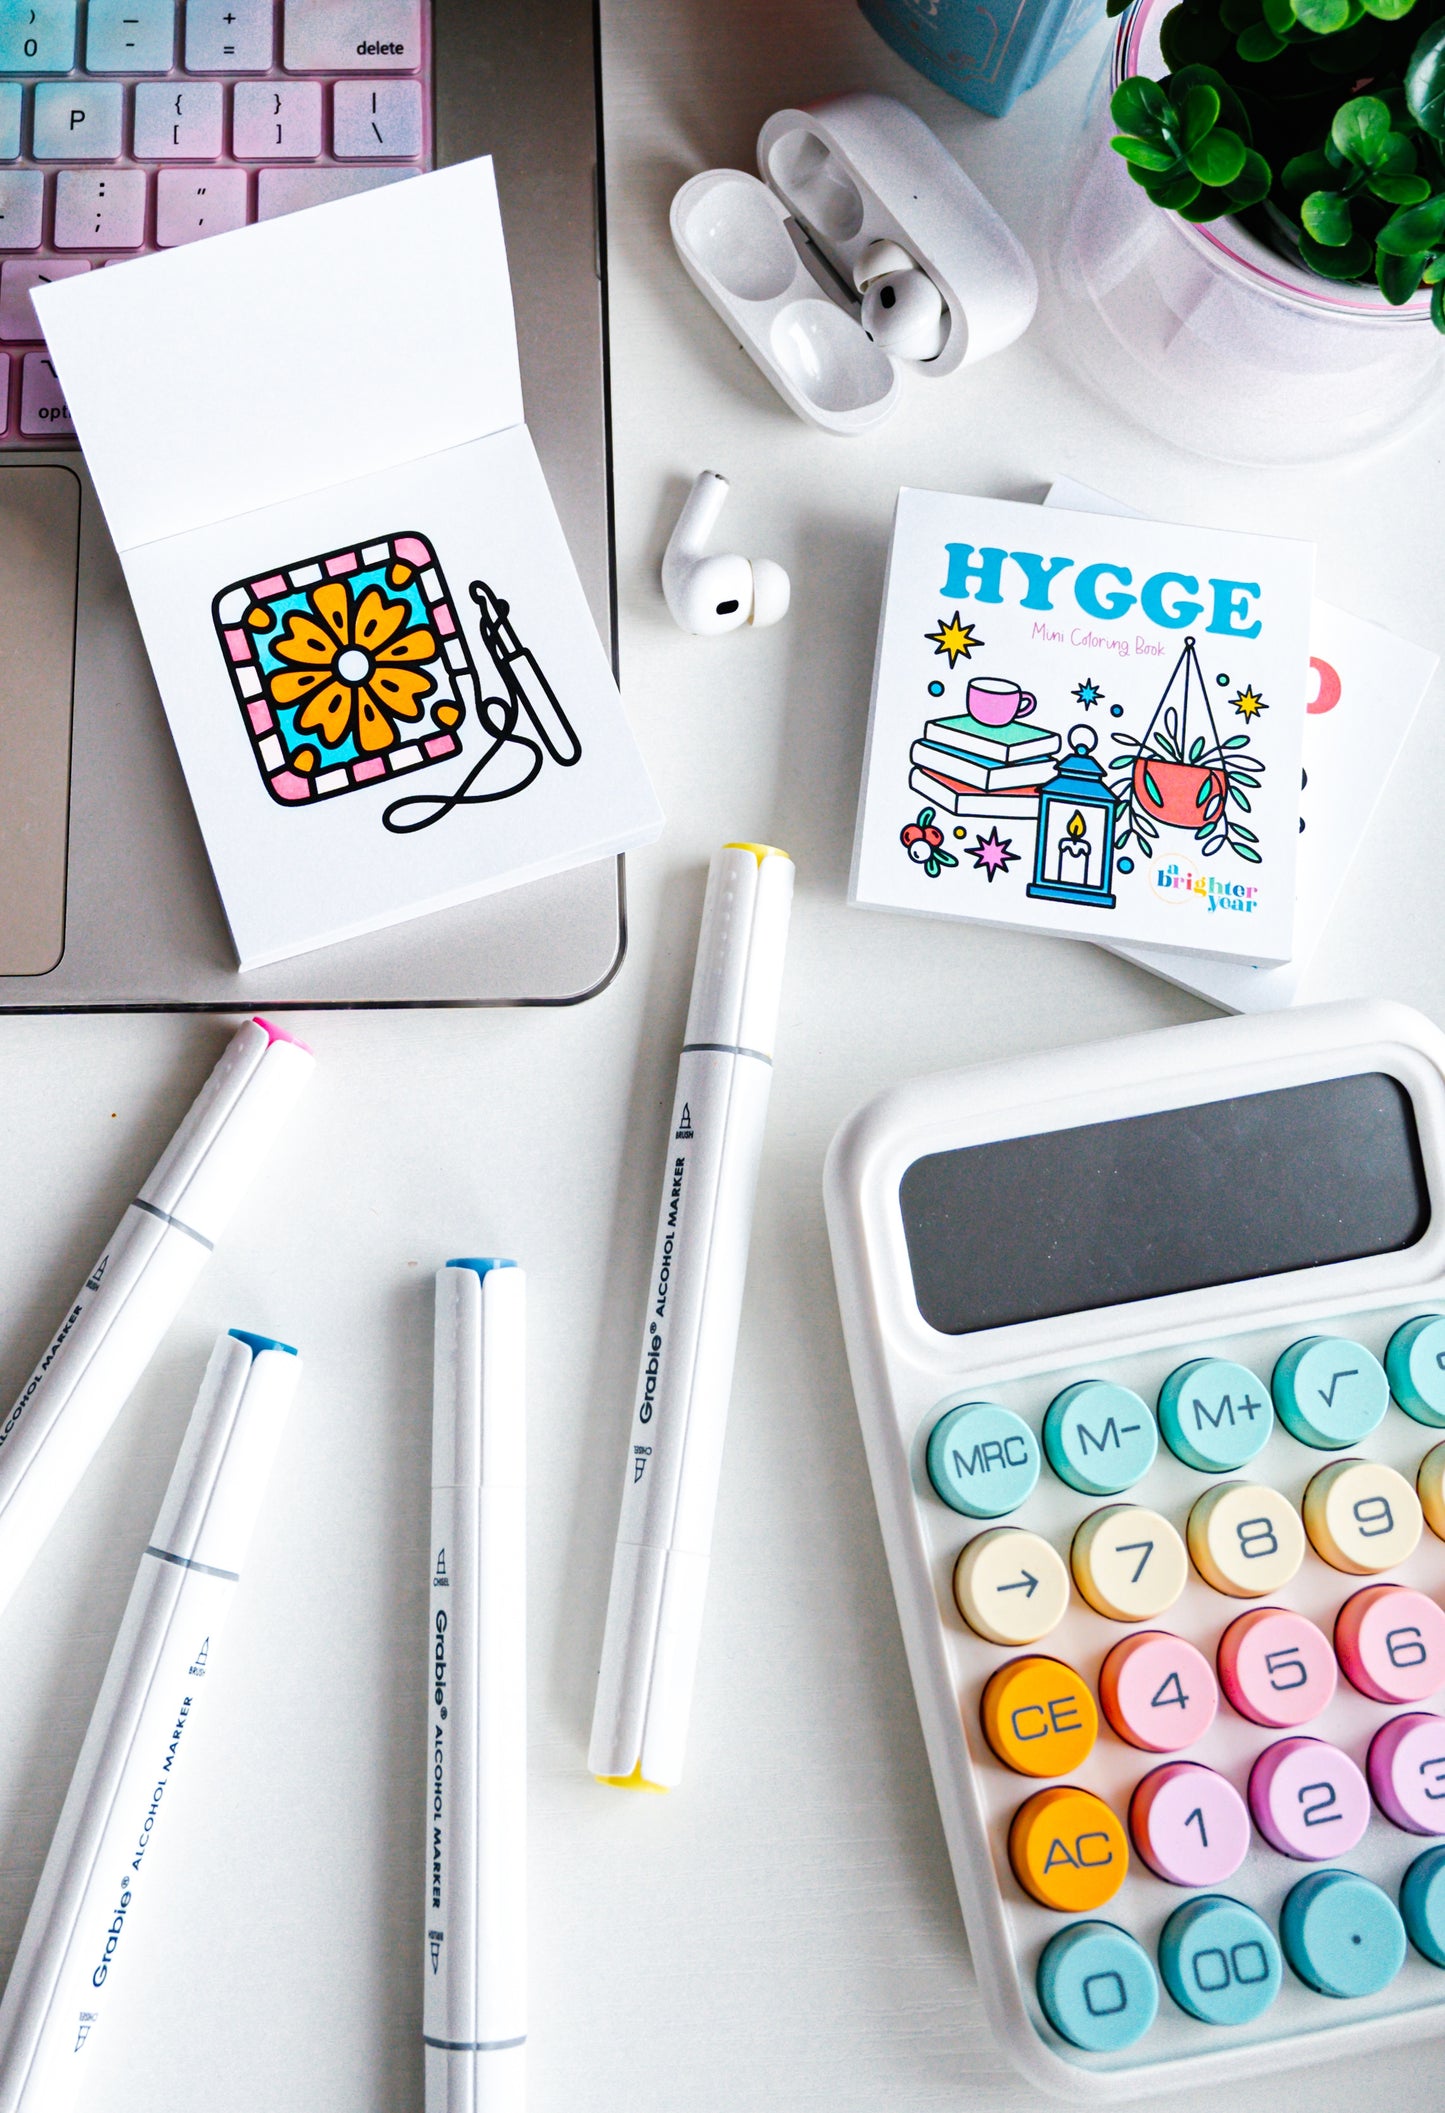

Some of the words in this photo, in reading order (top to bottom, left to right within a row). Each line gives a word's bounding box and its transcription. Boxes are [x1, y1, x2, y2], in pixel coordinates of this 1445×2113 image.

[356, 40, 405, 56] delete
[70, 109, 86, 131] P
[38, 405, 71, 422] opt
[939, 542, 1263, 641] HYGGE
[1032, 622, 1064, 642] Mini
[1070, 627, 1130, 657] Coloring
[1135, 635, 1166, 656] Book
[1157, 869, 1258, 899] brighter
[1167, 864, 1179, 875] a
[1207, 894, 1258, 913] year
[655, 1231, 675, 1317] ALCOHOL
[667, 1157, 685, 1227] MARKER
[0, 1374, 43, 1447] LCOHOL
[41, 1305, 83, 1371] MARKER
[1193, 1394, 1262, 1431] M+
[953, 1436, 1028, 1478] MRC
[1076, 1417, 1141, 1456] M-
[1353, 1496, 1394, 1537] 9
[1237, 1517, 1278, 1559] 8
[1115, 1541, 1154, 1583] 7
[1385, 1626, 1427, 1668] 6
[1265, 1647, 1307, 1691] 5
[1151, 1672, 1189, 1710] 4
[1010, 1695, 1083, 1742] CE
[131, 1778, 168, 1871] ALCOHOL
[162, 1696, 194, 1772] MARKER
[432, 1724, 443, 1822] ALCOHOL
[1298, 1782, 1343, 1827] 2
[1184, 1808, 1210, 1848] 1
[431, 1826, 441, 1909] MARKER
[1042, 1830, 1113, 1876] AC
[1192, 1940, 1270, 1993] 00
[1082, 1970, 1128, 2016] 0
